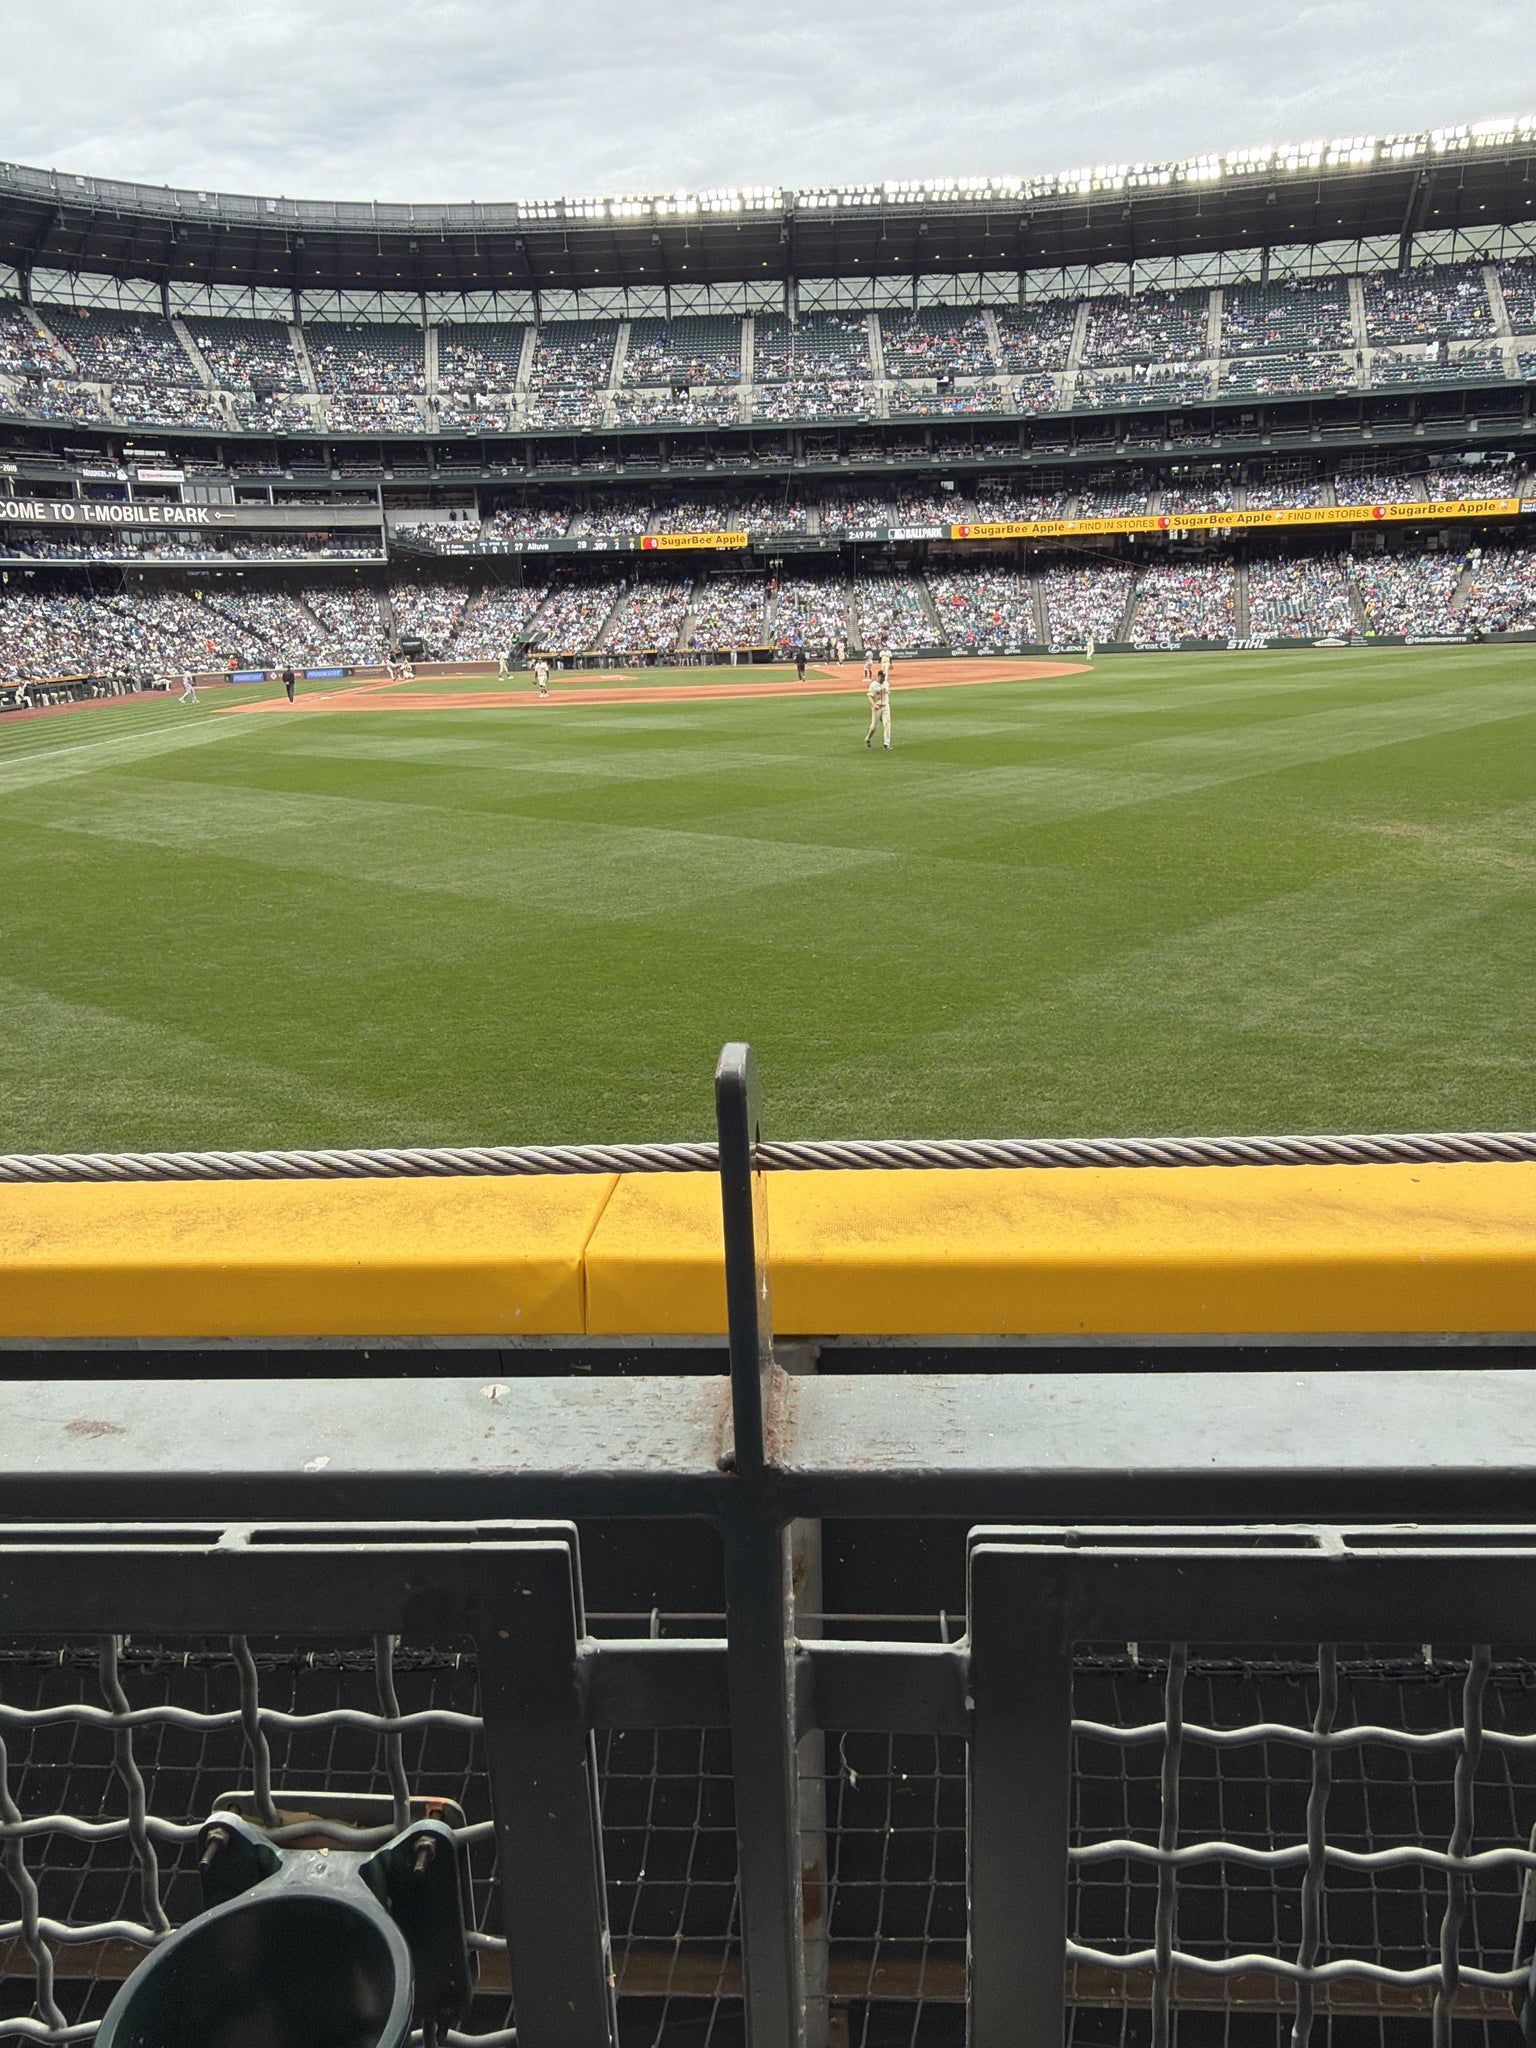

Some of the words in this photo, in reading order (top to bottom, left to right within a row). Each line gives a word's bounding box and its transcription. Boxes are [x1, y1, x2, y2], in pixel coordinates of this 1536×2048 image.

[50, 503, 75, 520] TO
[80, 504, 160, 522] T-MOBILE
[164, 507, 210, 523] PARK
[1390, 505, 1453, 516] SugarBee
[1458, 502, 1496, 513] Apple
[1288, 512, 1311, 520] FIND
[1315, 511, 1325, 519] IN
[1327, 509, 1369, 518] STORES
[1080, 522, 1101, 530] FIND
[1105, 521, 1113, 529] IN
[1116, 520, 1155, 528] STORES
[1174, 515, 1232, 526] SugarBee
[1237, 514, 1272, 523] Apple
[906, 528, 942, 538] BALLPARK
[973, 525, 1028, 536] SugarBee
[1032, 523, 1065, 534] Apple
[848, 531, 863, 540] 2:49
[865, 530, 877, 539] PM
[661, 536, 712, 546] SugarBee
[716, 535, 746, 544] Apple
[514, 542, 523, 551] 27
[577, 541, 587, 549] 2B
[1134, 641, 1159, 650] Great
[1160, 641, 1182, 651] Clips
[1226, 639, 1268, 649] STIHL
